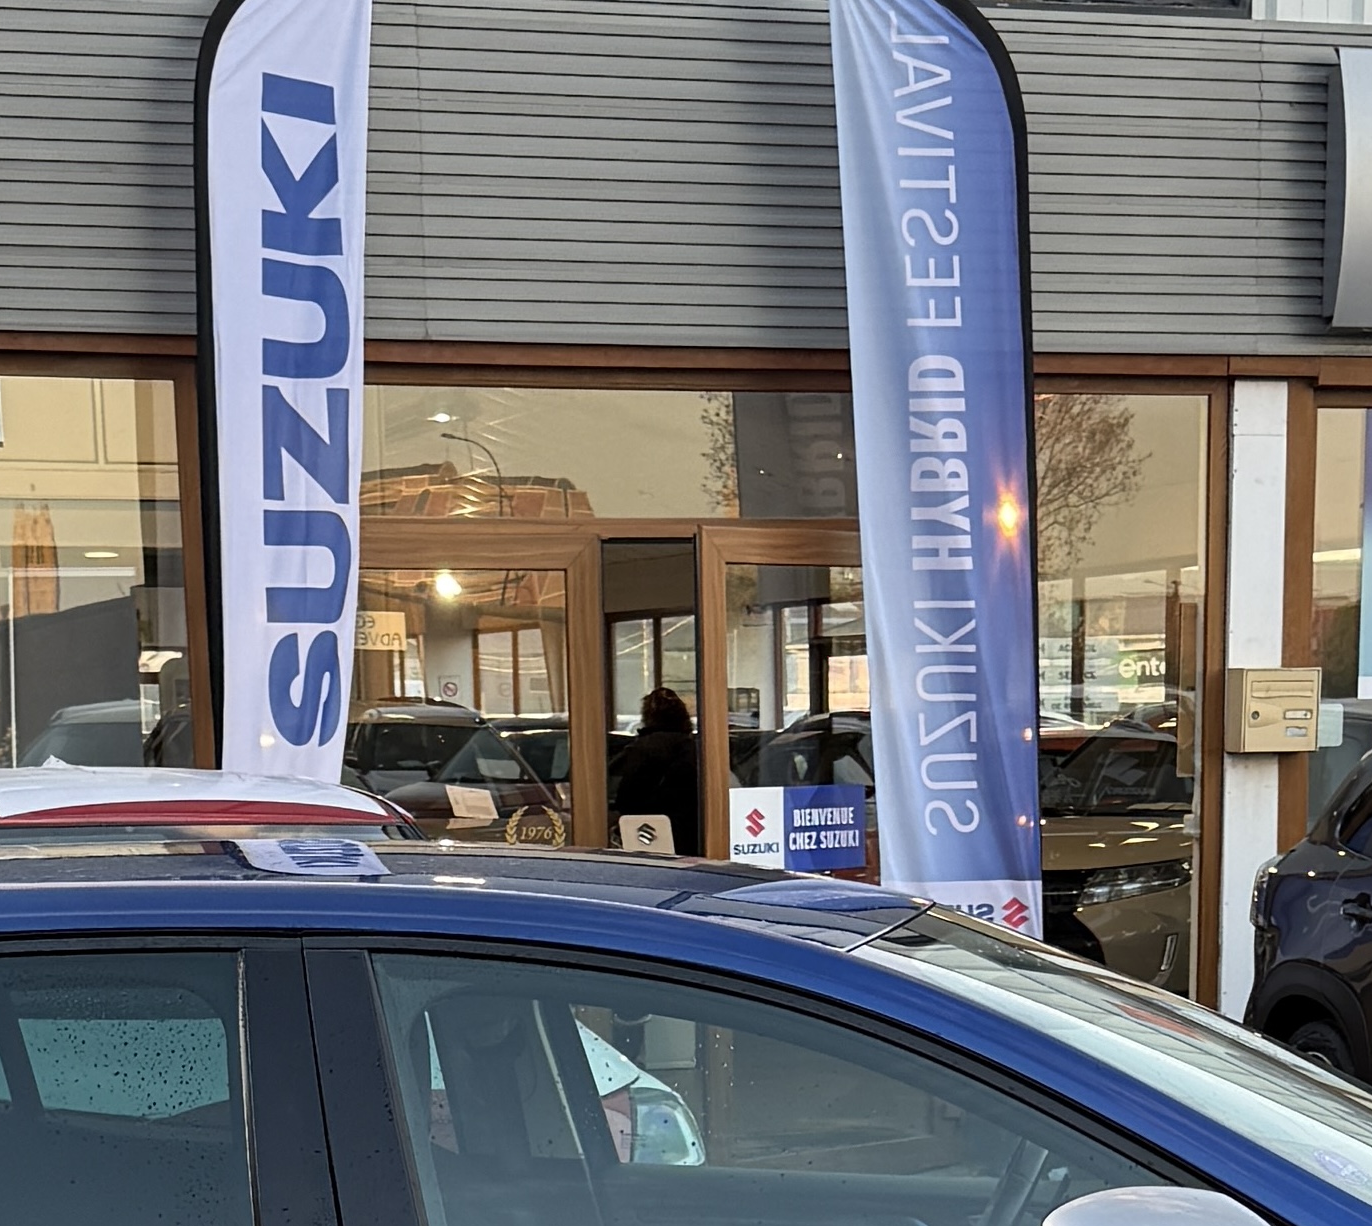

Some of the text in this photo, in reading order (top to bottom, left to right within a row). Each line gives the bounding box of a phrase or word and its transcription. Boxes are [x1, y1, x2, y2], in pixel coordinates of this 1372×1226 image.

[262, 72, 351, 747] SUZUKI
[793, 806, 855, 828] BIENVENUE
[520, 826, 553, 840] 1976
[789, 829, 859, 851] CHEZ SUZUKI
[733, 842, 780, 855] SUZUKI
